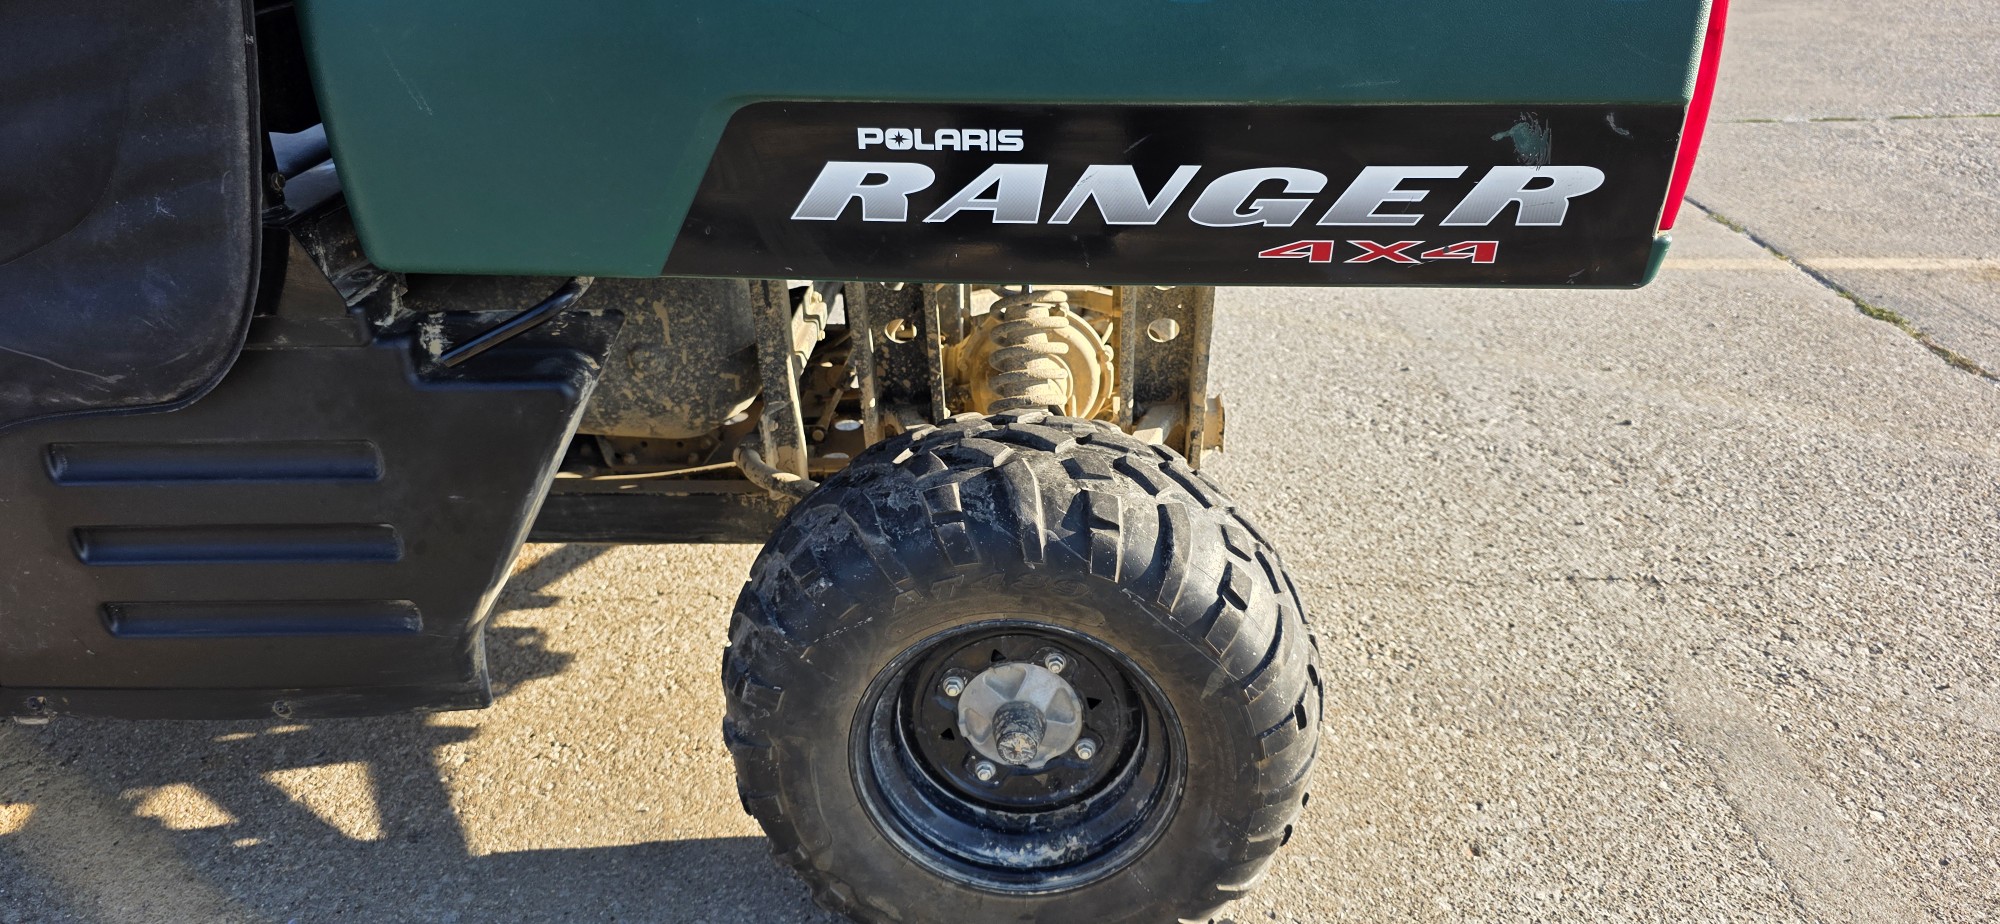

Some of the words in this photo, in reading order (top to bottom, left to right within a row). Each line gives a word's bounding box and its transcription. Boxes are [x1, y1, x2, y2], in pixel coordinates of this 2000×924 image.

[857, 127, 1024, 152] POLARIS
[791, 161, 1606, 228] RANGER
[1258, 239, 1500, 264] 4X4
